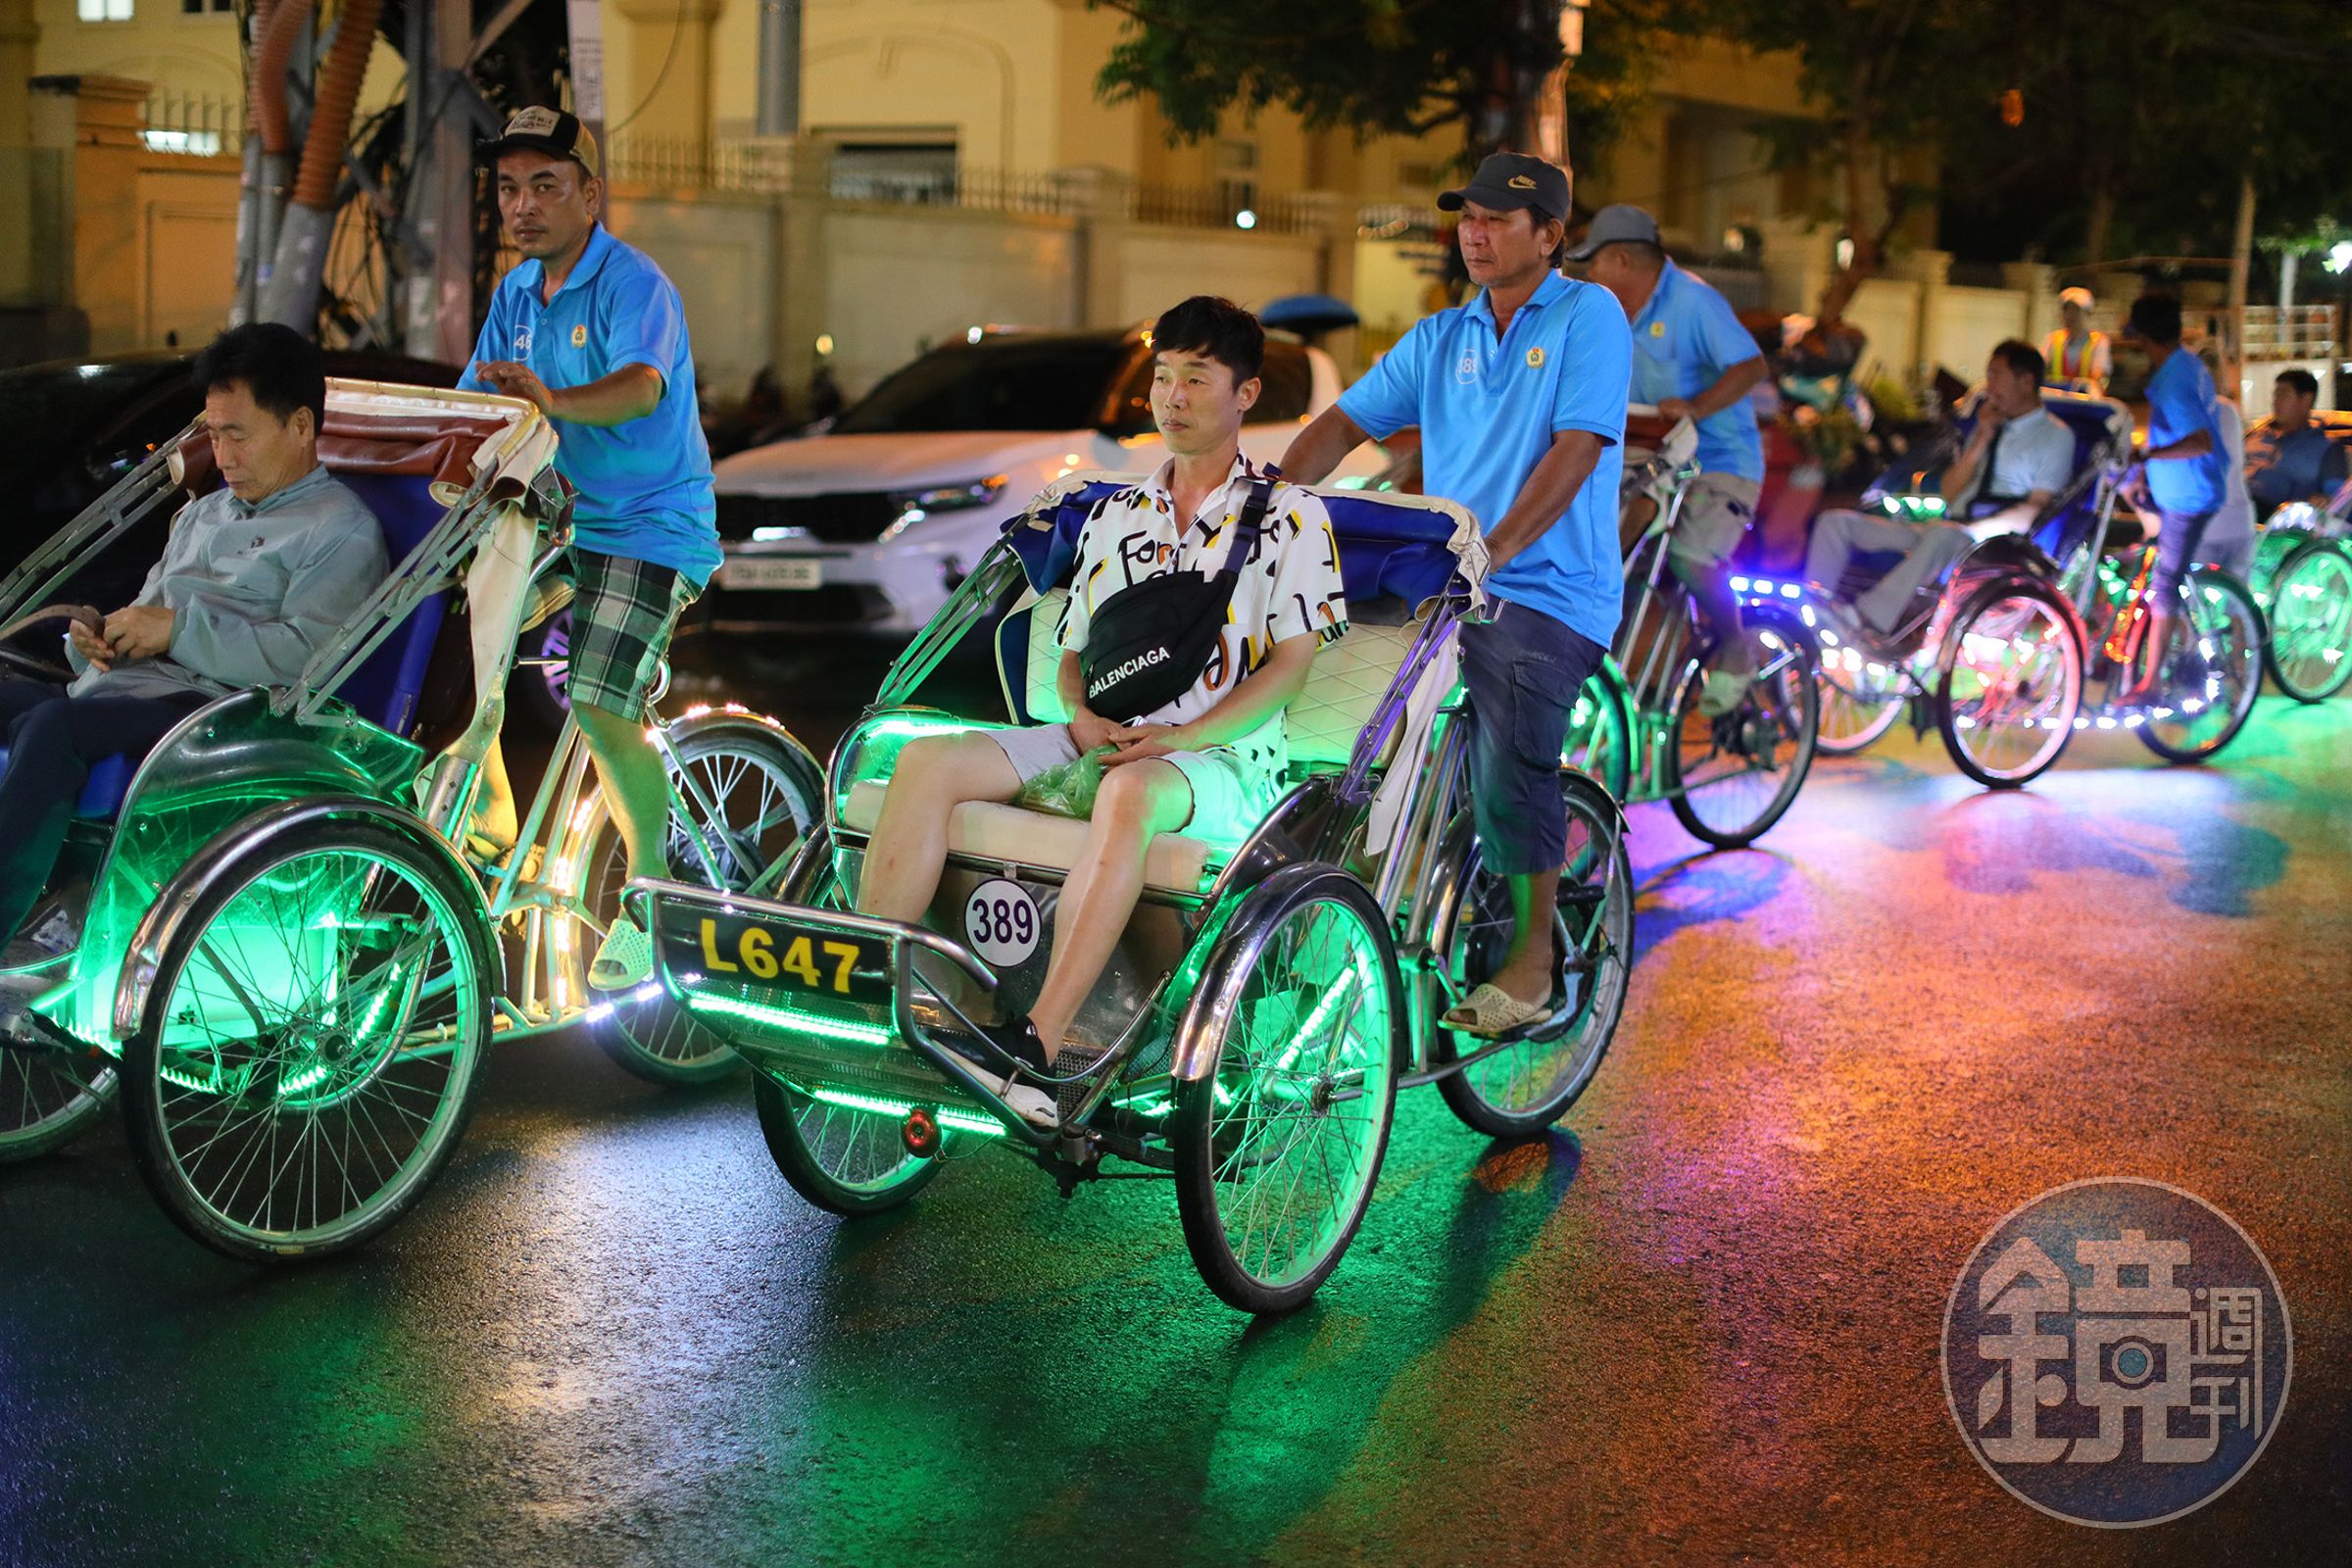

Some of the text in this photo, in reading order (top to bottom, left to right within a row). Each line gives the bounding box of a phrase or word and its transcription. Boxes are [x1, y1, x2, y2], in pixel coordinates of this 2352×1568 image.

[1089, 647, 1171, 699] BALENCIAGA
[972, 899, 1033, 945] 389
[701, 918, 860, 994] L647
